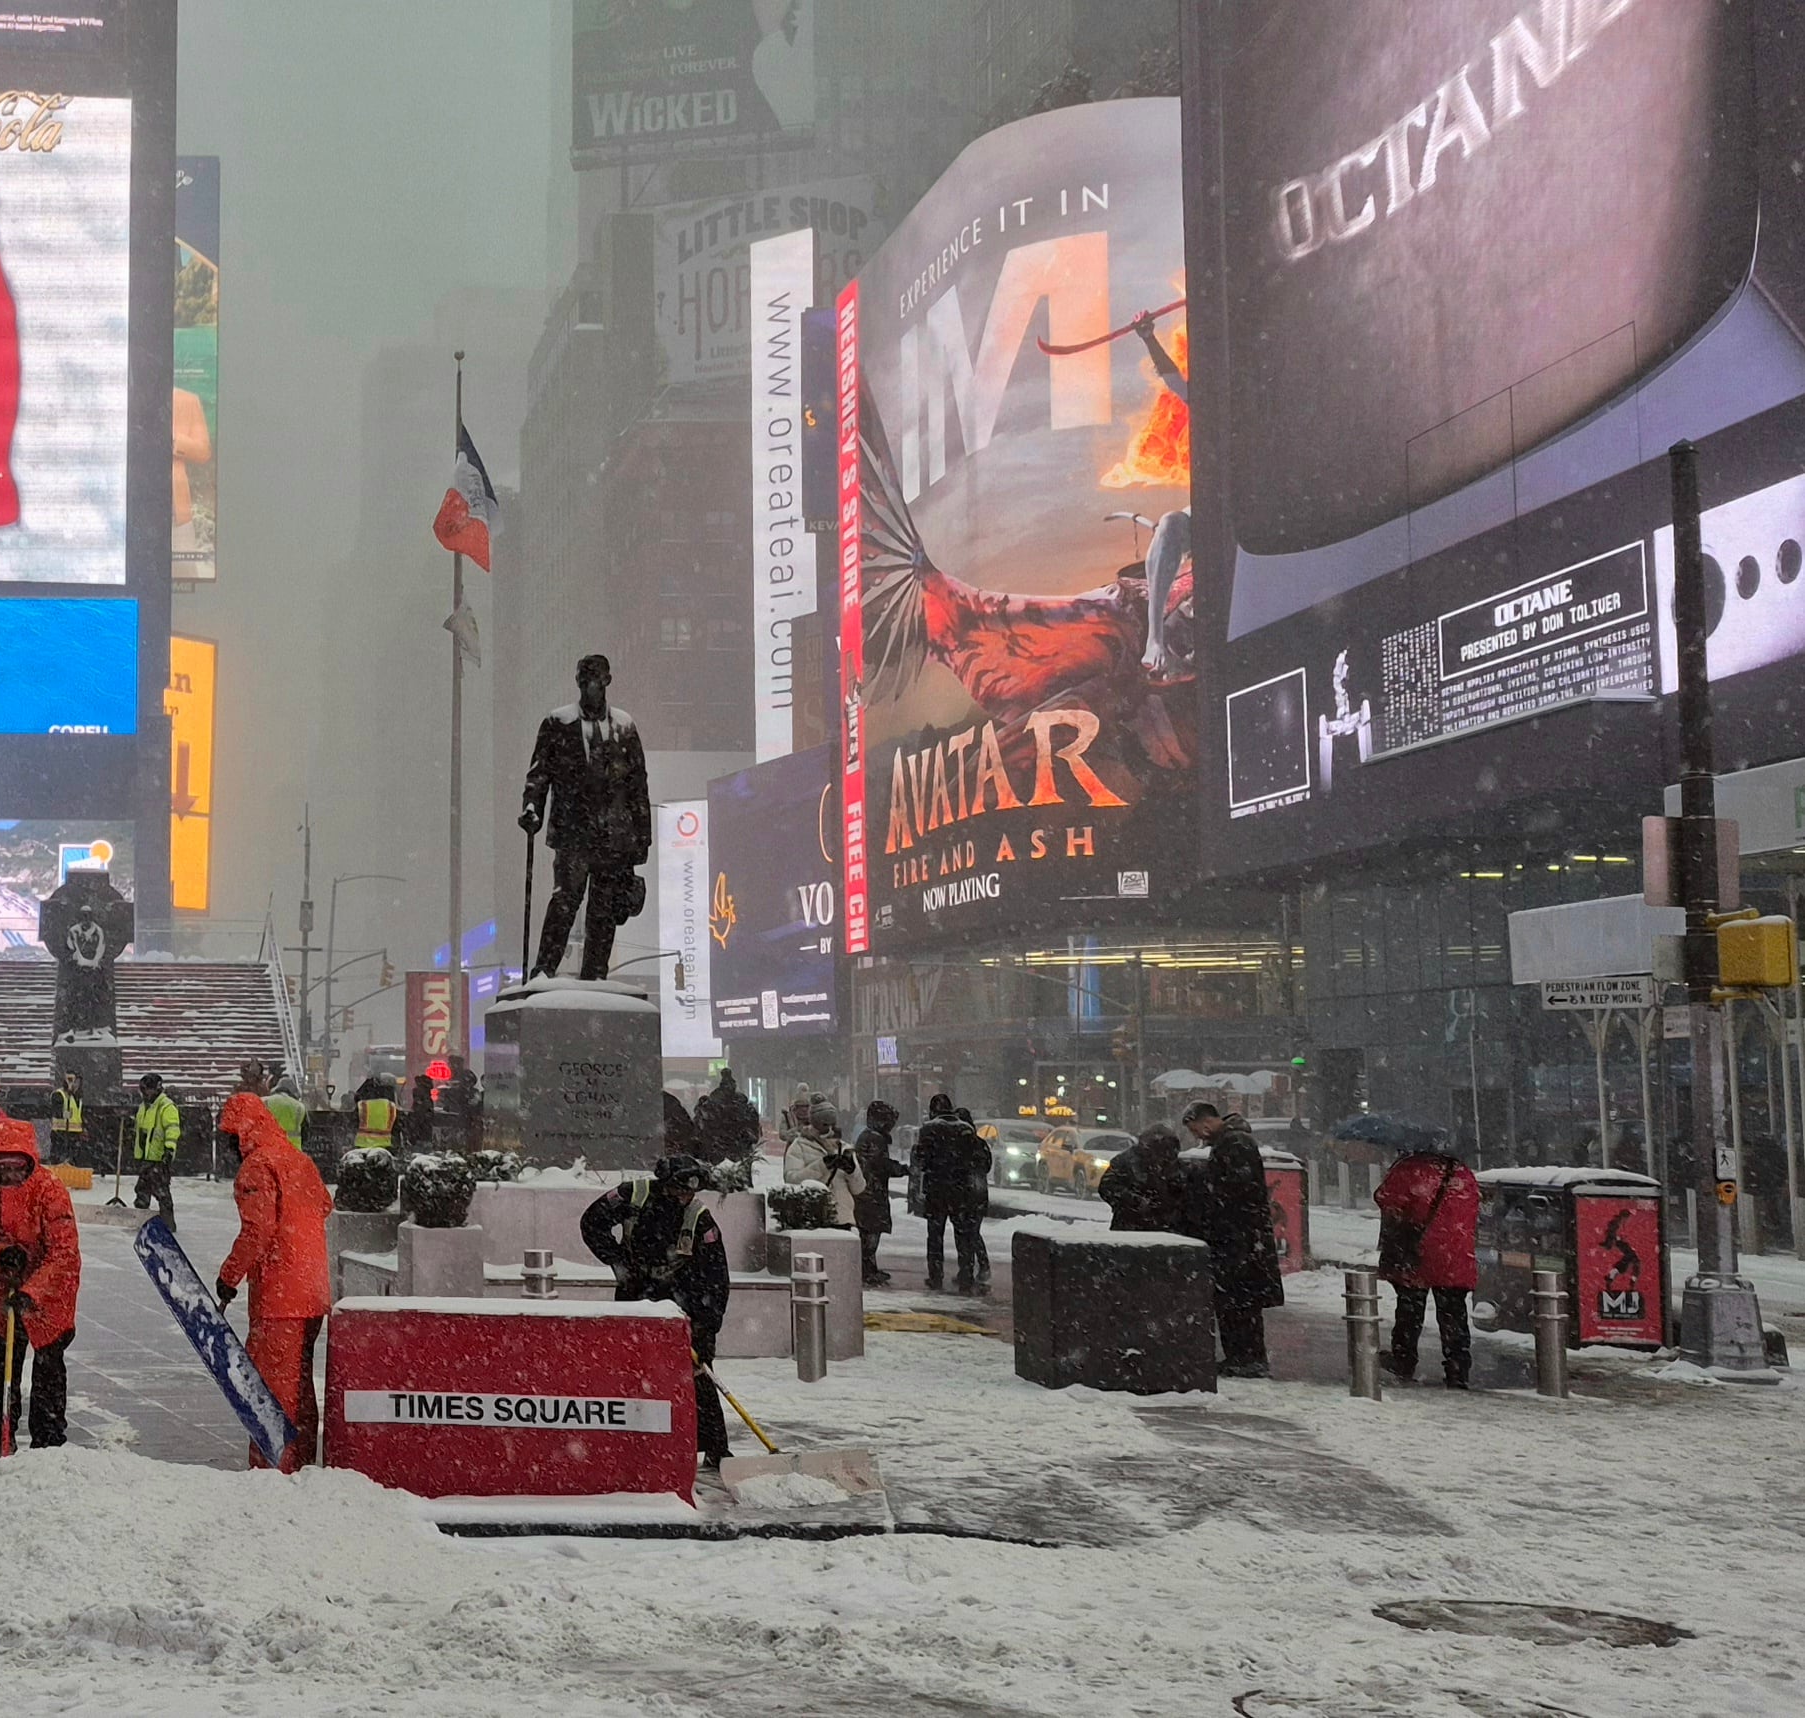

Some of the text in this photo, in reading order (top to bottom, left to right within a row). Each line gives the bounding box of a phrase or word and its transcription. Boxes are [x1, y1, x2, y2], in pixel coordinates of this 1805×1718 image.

[663, 45, 696, 59] LIVE
[677, 196, 868, 265] LITTLE SHOP
[900, 183, 1109, 319] EXPERIENCE IT IN
[840, 299, 861, 614] HERSHEY'S STORE
[1494, 578, 1574, 627] OCTANE
[1460, 592, 1621, 662] PRESENTED BY DON TOLIVER
[1584, 630, 1627, 652] SYNTHESIS
[1630, 622, 1651, 637] USED
[1544, 657, 1584, 678] COMBINING
[1588, 637, 1651, 664] LOW-INTENSITY
[1618, 651, 1652, 669] THROUGH
[1502, 699, 1536, 716] REPEATED
[1582, 669, 1638, 693] INTERFERENCE
[1642, 665, 1652, 677] IS
[885, 709, 1130, 855] AVATAR
[847, 801, 866, 953] FREE CH
[893, 825, 1095, 889] FIRE AND ASH
[922, 872, 1002, 913] NOW PLAYING
[1545, 980, 1642, 993] PEDESTRIAN FLOW ZONE
[1590, 993, 1644, 1005] KEEP MOVING
[559, 1062, 627, 1079] GEORGE
[1602, 1290, 1640, 1314] MJ
[389, 1394, 627, 1427] TIMES SQUARE
